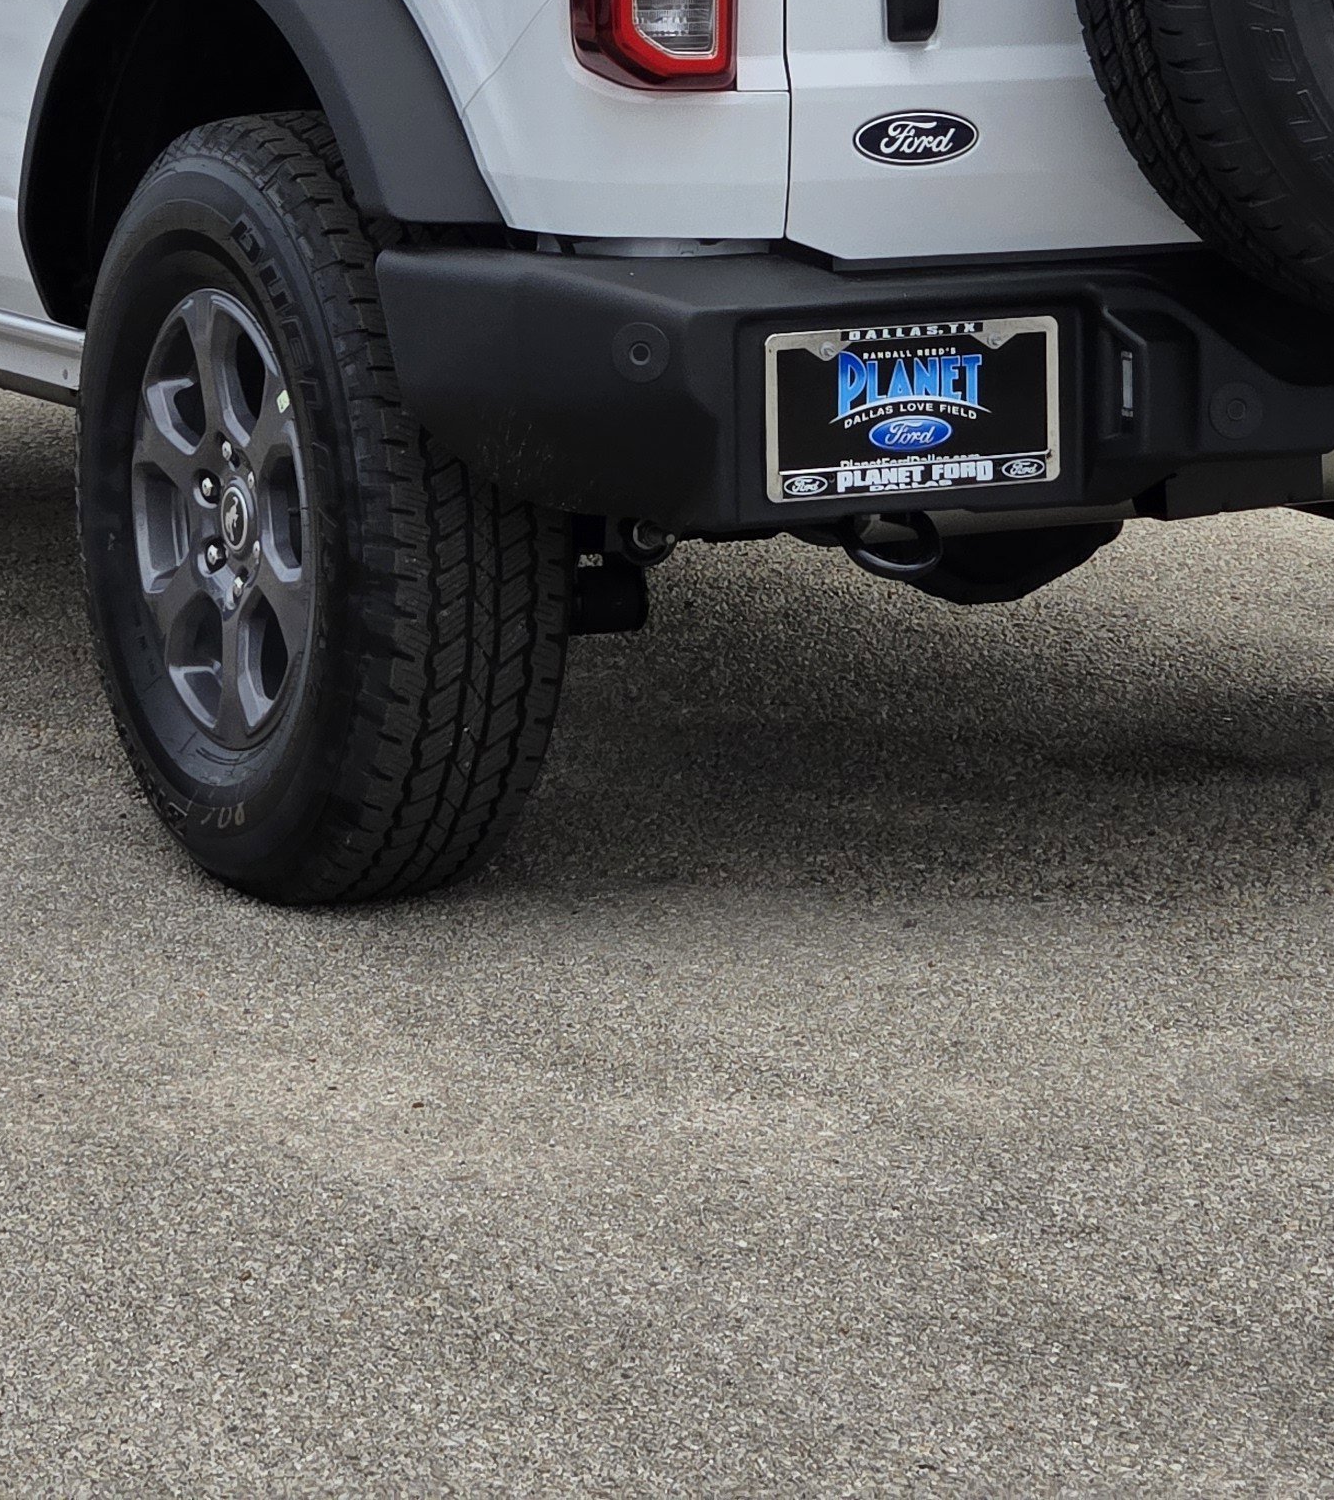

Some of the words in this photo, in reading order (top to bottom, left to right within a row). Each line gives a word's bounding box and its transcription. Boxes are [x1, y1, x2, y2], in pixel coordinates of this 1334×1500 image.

[880, 121, 956, 154] Ford
[949, 323, 975, 334] TX
[863, 350, 912, 360] RANDALL
[917, 347, 956, 357] REED'S
[838, 350, 982, 417] PLANET
[844, 406, 894, 429] DALLAS
[900, 403, 934, 412] LOVE
[940, 405, 977, 419] FIELD
[884, 420, 936, 445] Ford
[837, 465, 925, 493] PLANET
[932, 460, 993, 481] FORD
